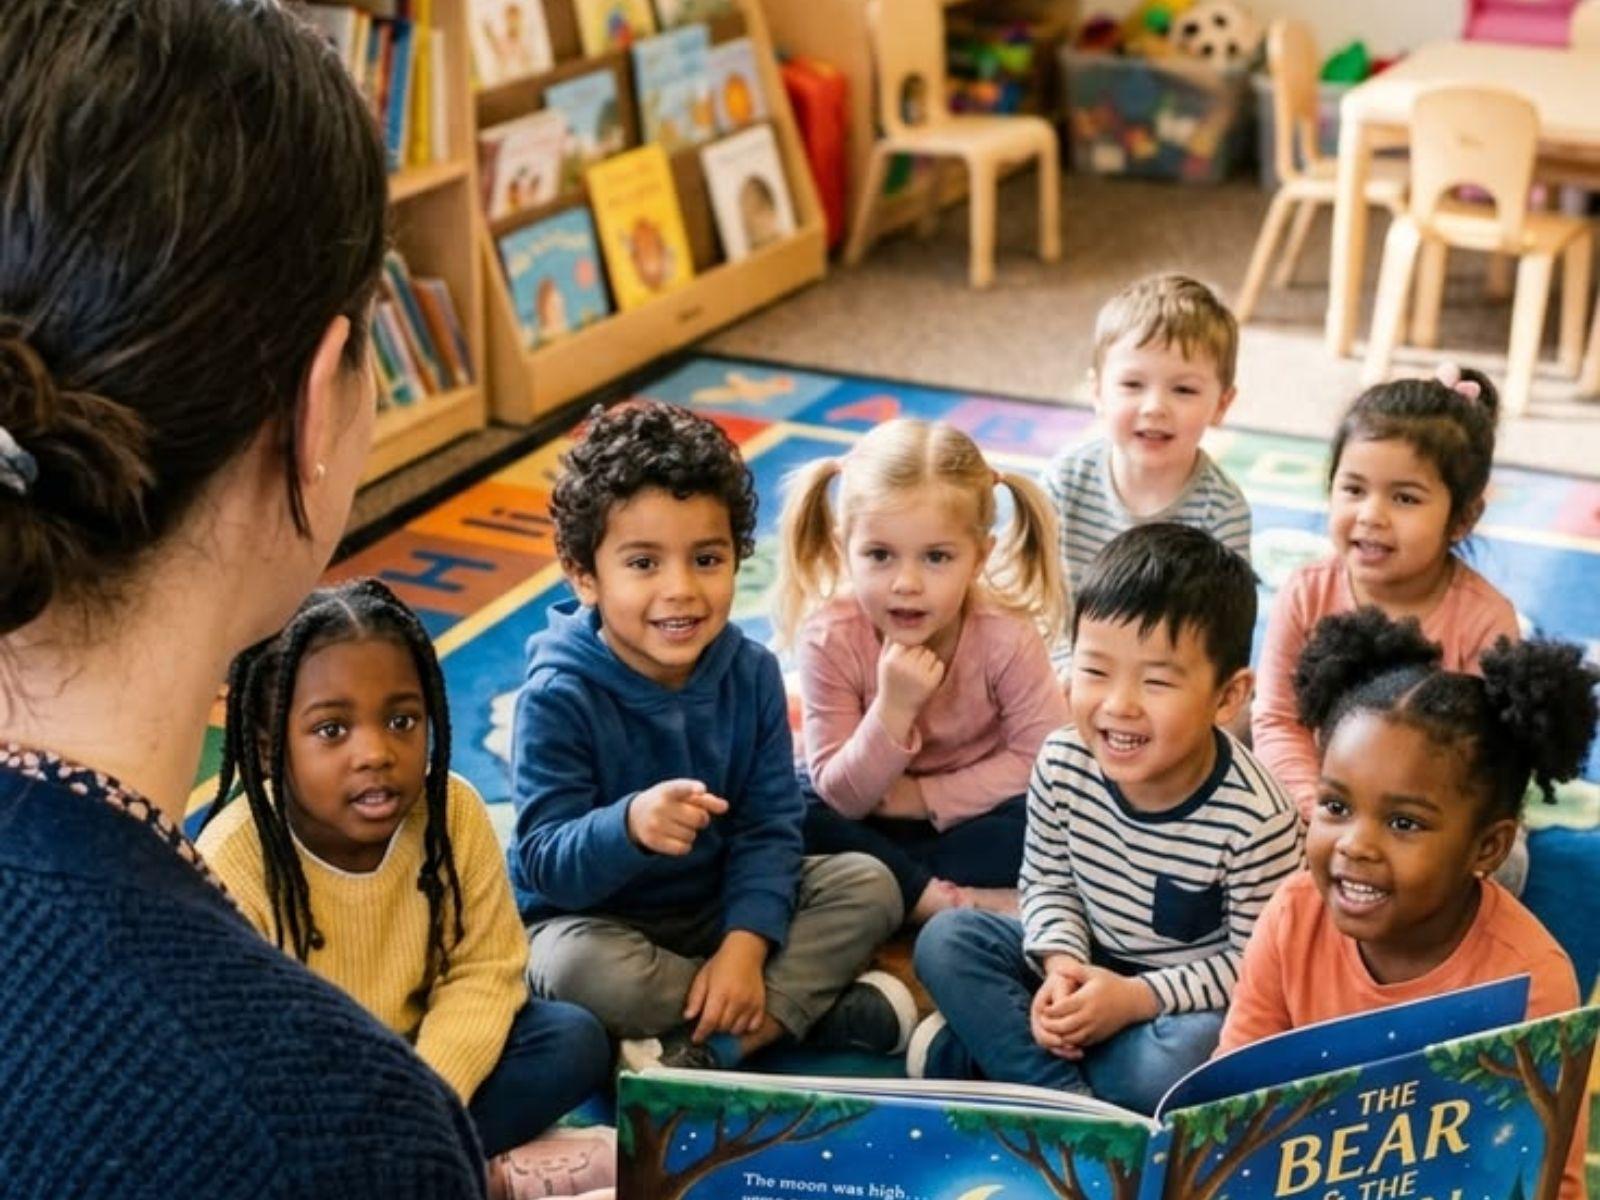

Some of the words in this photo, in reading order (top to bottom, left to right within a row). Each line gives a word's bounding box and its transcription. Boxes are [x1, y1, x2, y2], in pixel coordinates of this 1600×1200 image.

[379, 549, 498, 593] H
[1358, 1080, 1420, 1116] THE
[1274, 1099, 1471, 1198] BEAR
[743, 1172, 777, 1188] The
[780, 1177, 827, 1193] moon
[832, 1183, 864, 1196] was
[1358, 1169, 1420, 1200] THE
